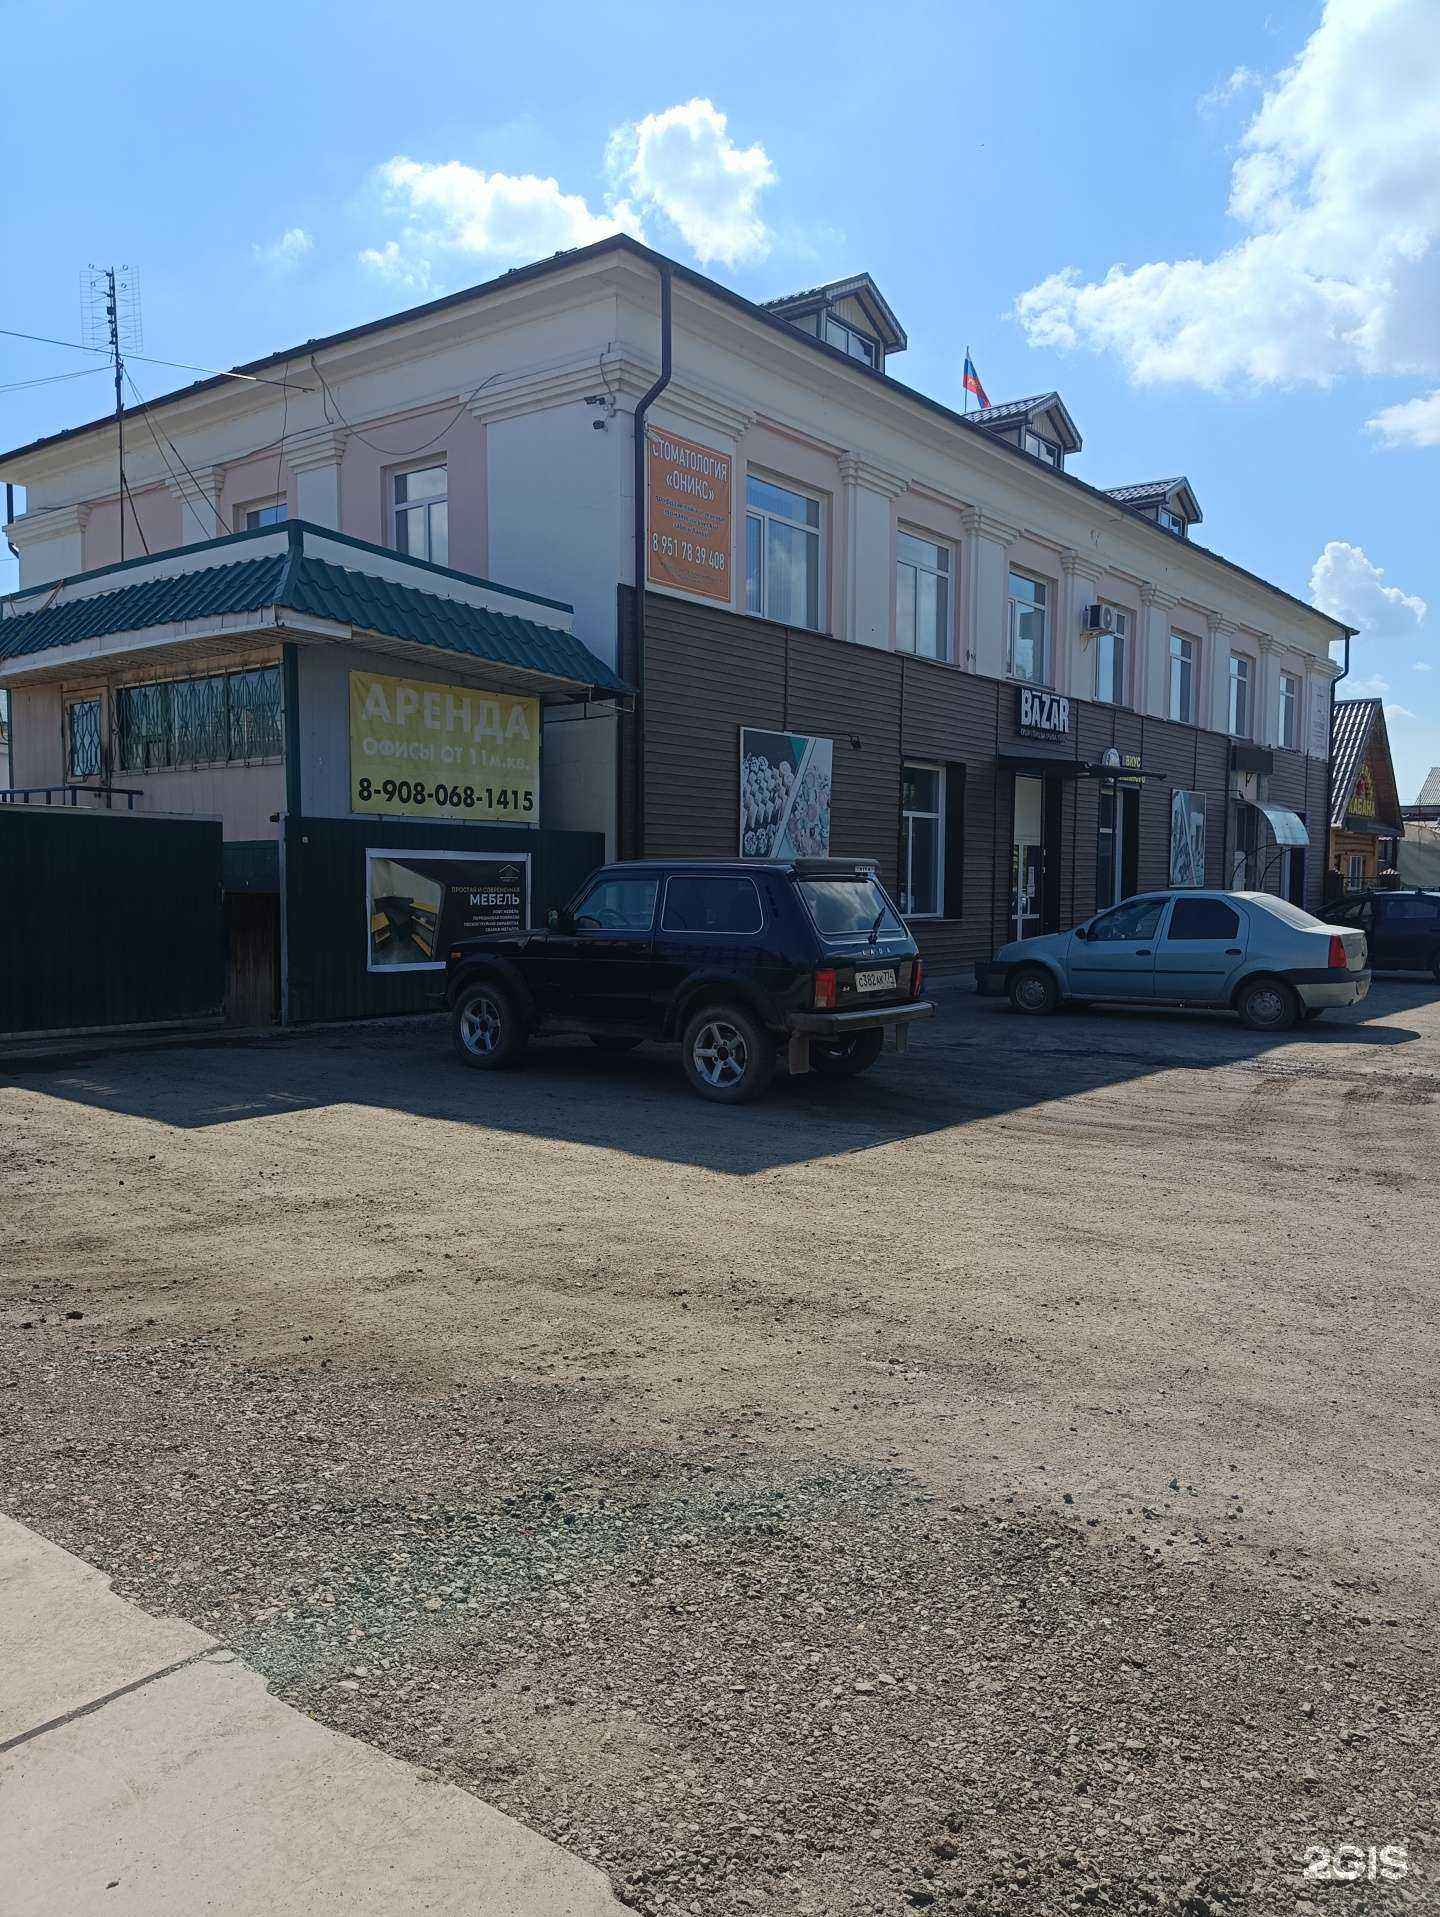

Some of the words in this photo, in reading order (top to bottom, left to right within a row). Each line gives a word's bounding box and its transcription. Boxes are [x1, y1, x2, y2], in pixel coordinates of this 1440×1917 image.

[652, 438, 728, 482] СТОМАТОЛОГИЯ
[666, 470, 715, 501] «ОНИКС»
[652, 532, 664, 551] 8
[661, 535, 678, 558] 951
[682, 539, 694, 562] 78
[695, 545, 707, 565] 39
[708, 549, 726, 570] 408
[361, 683, 530, 745] АРЕНДА
[358, 777, 535, 812] 8-908-068-1415
[470, 893, 520, 906] МЕБЕЛЬ
[862, 946, 891, 956] LADA
